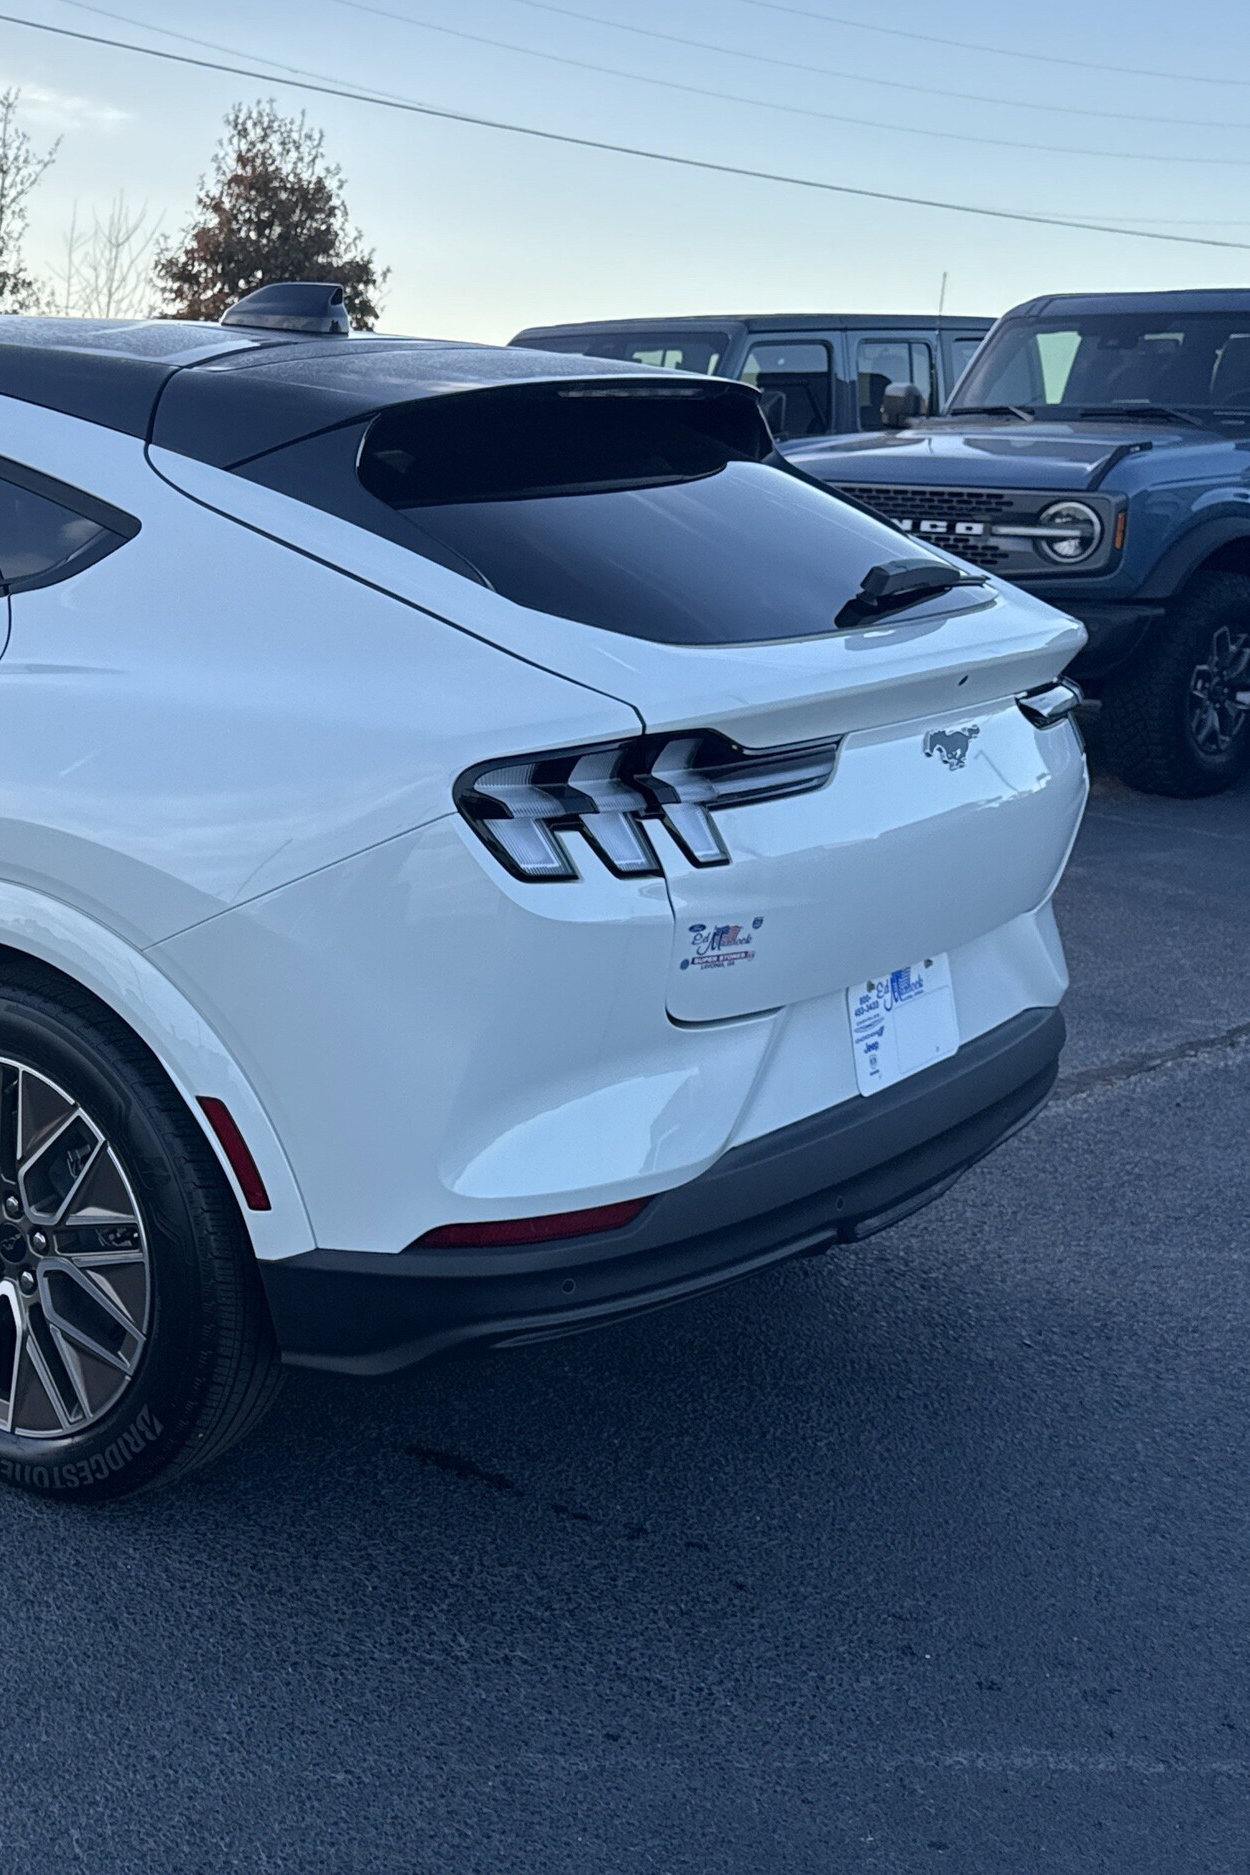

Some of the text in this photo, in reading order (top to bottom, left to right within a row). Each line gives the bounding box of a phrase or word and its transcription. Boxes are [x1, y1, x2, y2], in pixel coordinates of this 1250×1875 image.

[890, 518, 984, 535] NCO
[691, 931, 711, 946] Ed
[876, 979, 890, 999] Ed
[864, 1041, 879, 1054] Jeep
[0, 1403, 165, 1490] BRIDGESTONE
